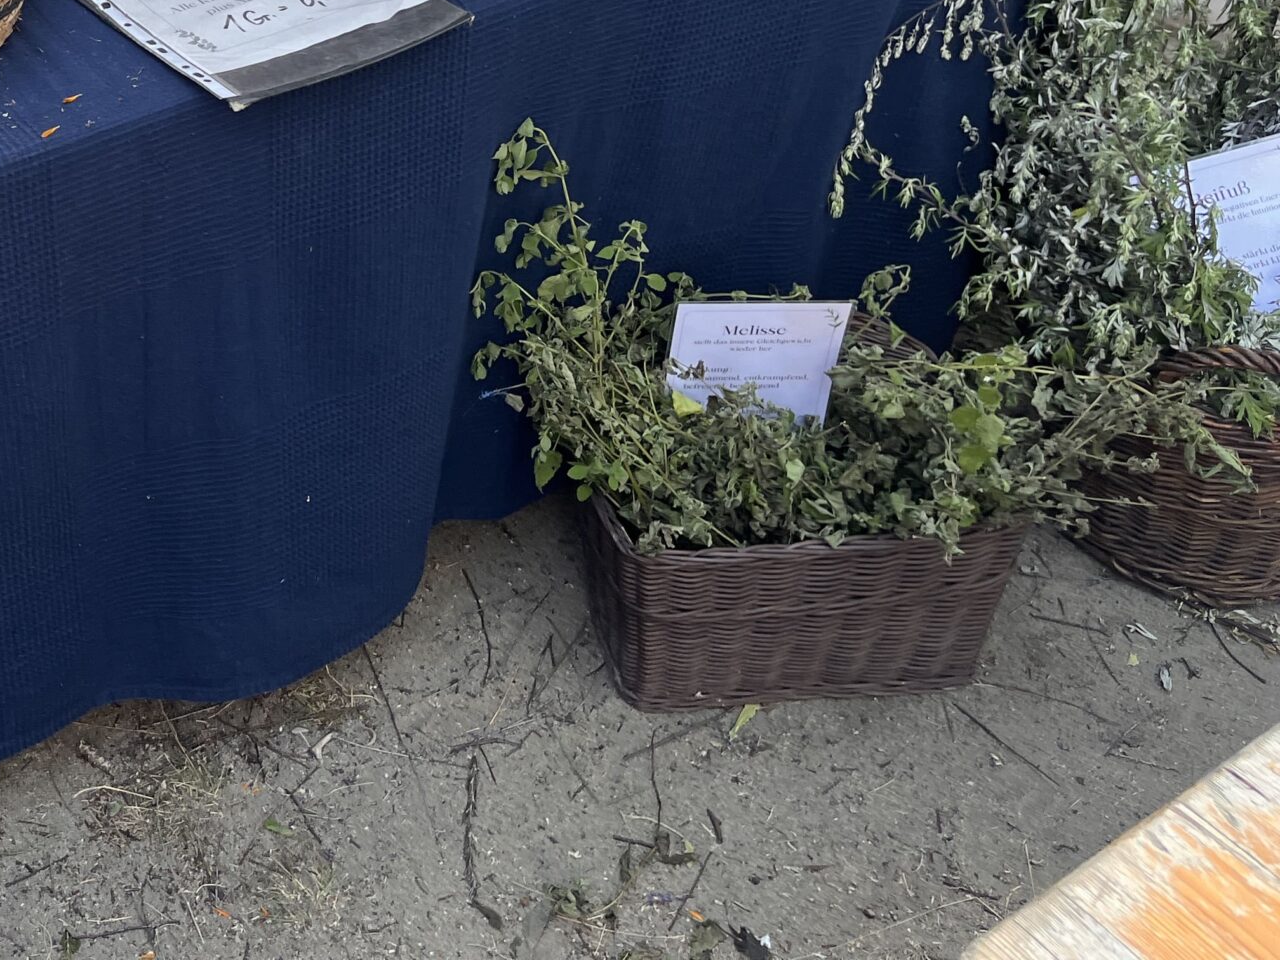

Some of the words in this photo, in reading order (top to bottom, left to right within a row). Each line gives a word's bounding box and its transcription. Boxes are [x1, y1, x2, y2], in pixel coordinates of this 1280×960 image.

[170, 0, 200, 16] Alle
[205, 2, 233, 17] plus
[723, 324, 787, 337] Melisse
